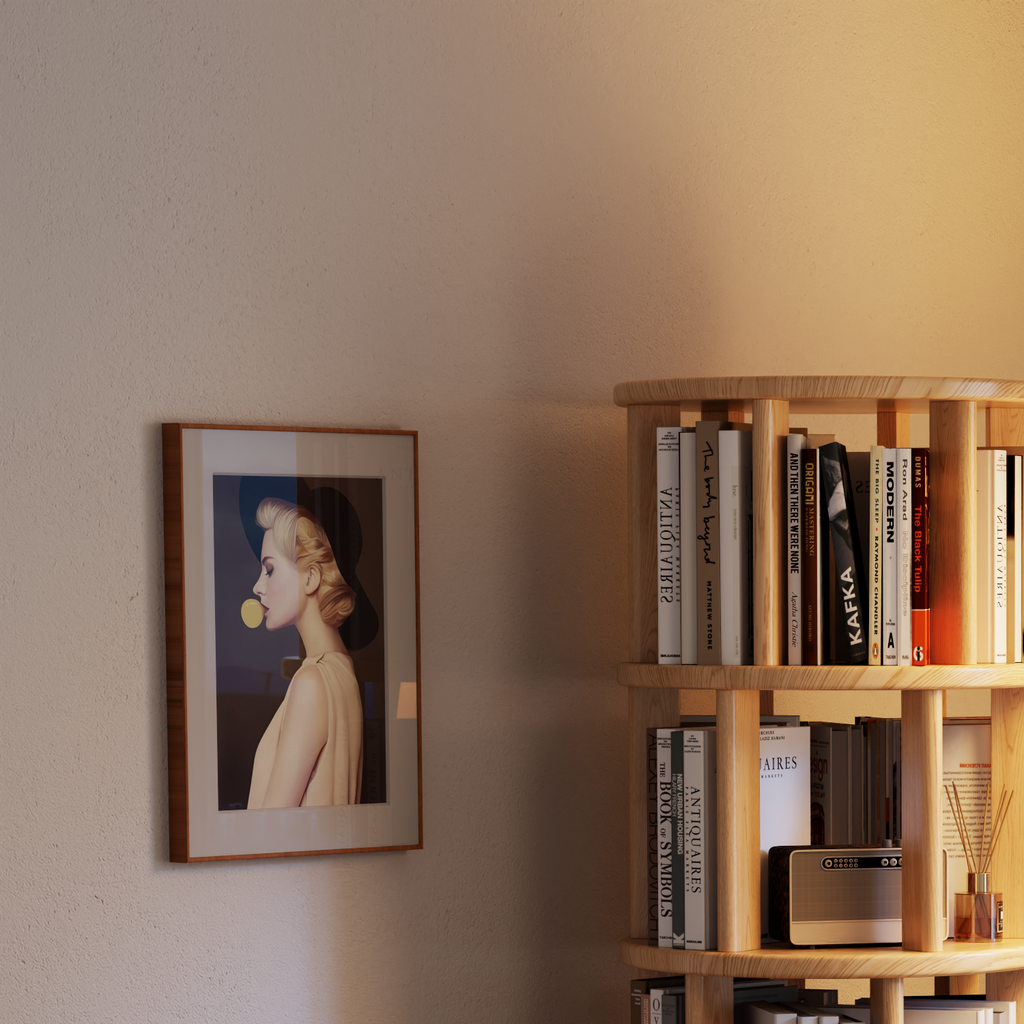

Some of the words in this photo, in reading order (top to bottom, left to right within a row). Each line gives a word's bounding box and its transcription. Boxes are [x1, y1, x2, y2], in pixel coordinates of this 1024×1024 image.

[702, 441, 714, 472] The
[790, 453, 798, 470] AND
[790, 474, 799, 495] THEN
[805, 462, 814, 505] ORIGAMI
[790, 496, 799, 524] THERE
[790, 525, 799, 550] WERE
[914, 530, 922, 562] Black
[790, 551, 799, 574] NONE
[913, 566, 922, 593] Tulip
[840, 566, 862, 646] KAFKA
[888, 632, 894, 648] A
[648, 734, 657, 801] ALEXEY
[660, 782, 671, 824] BOOK
[660, 828, 666, 838] OF
[689, 786, 701, 893] ANTIQUAIRES
[660, 842, 672, 918] SYMBOLS
